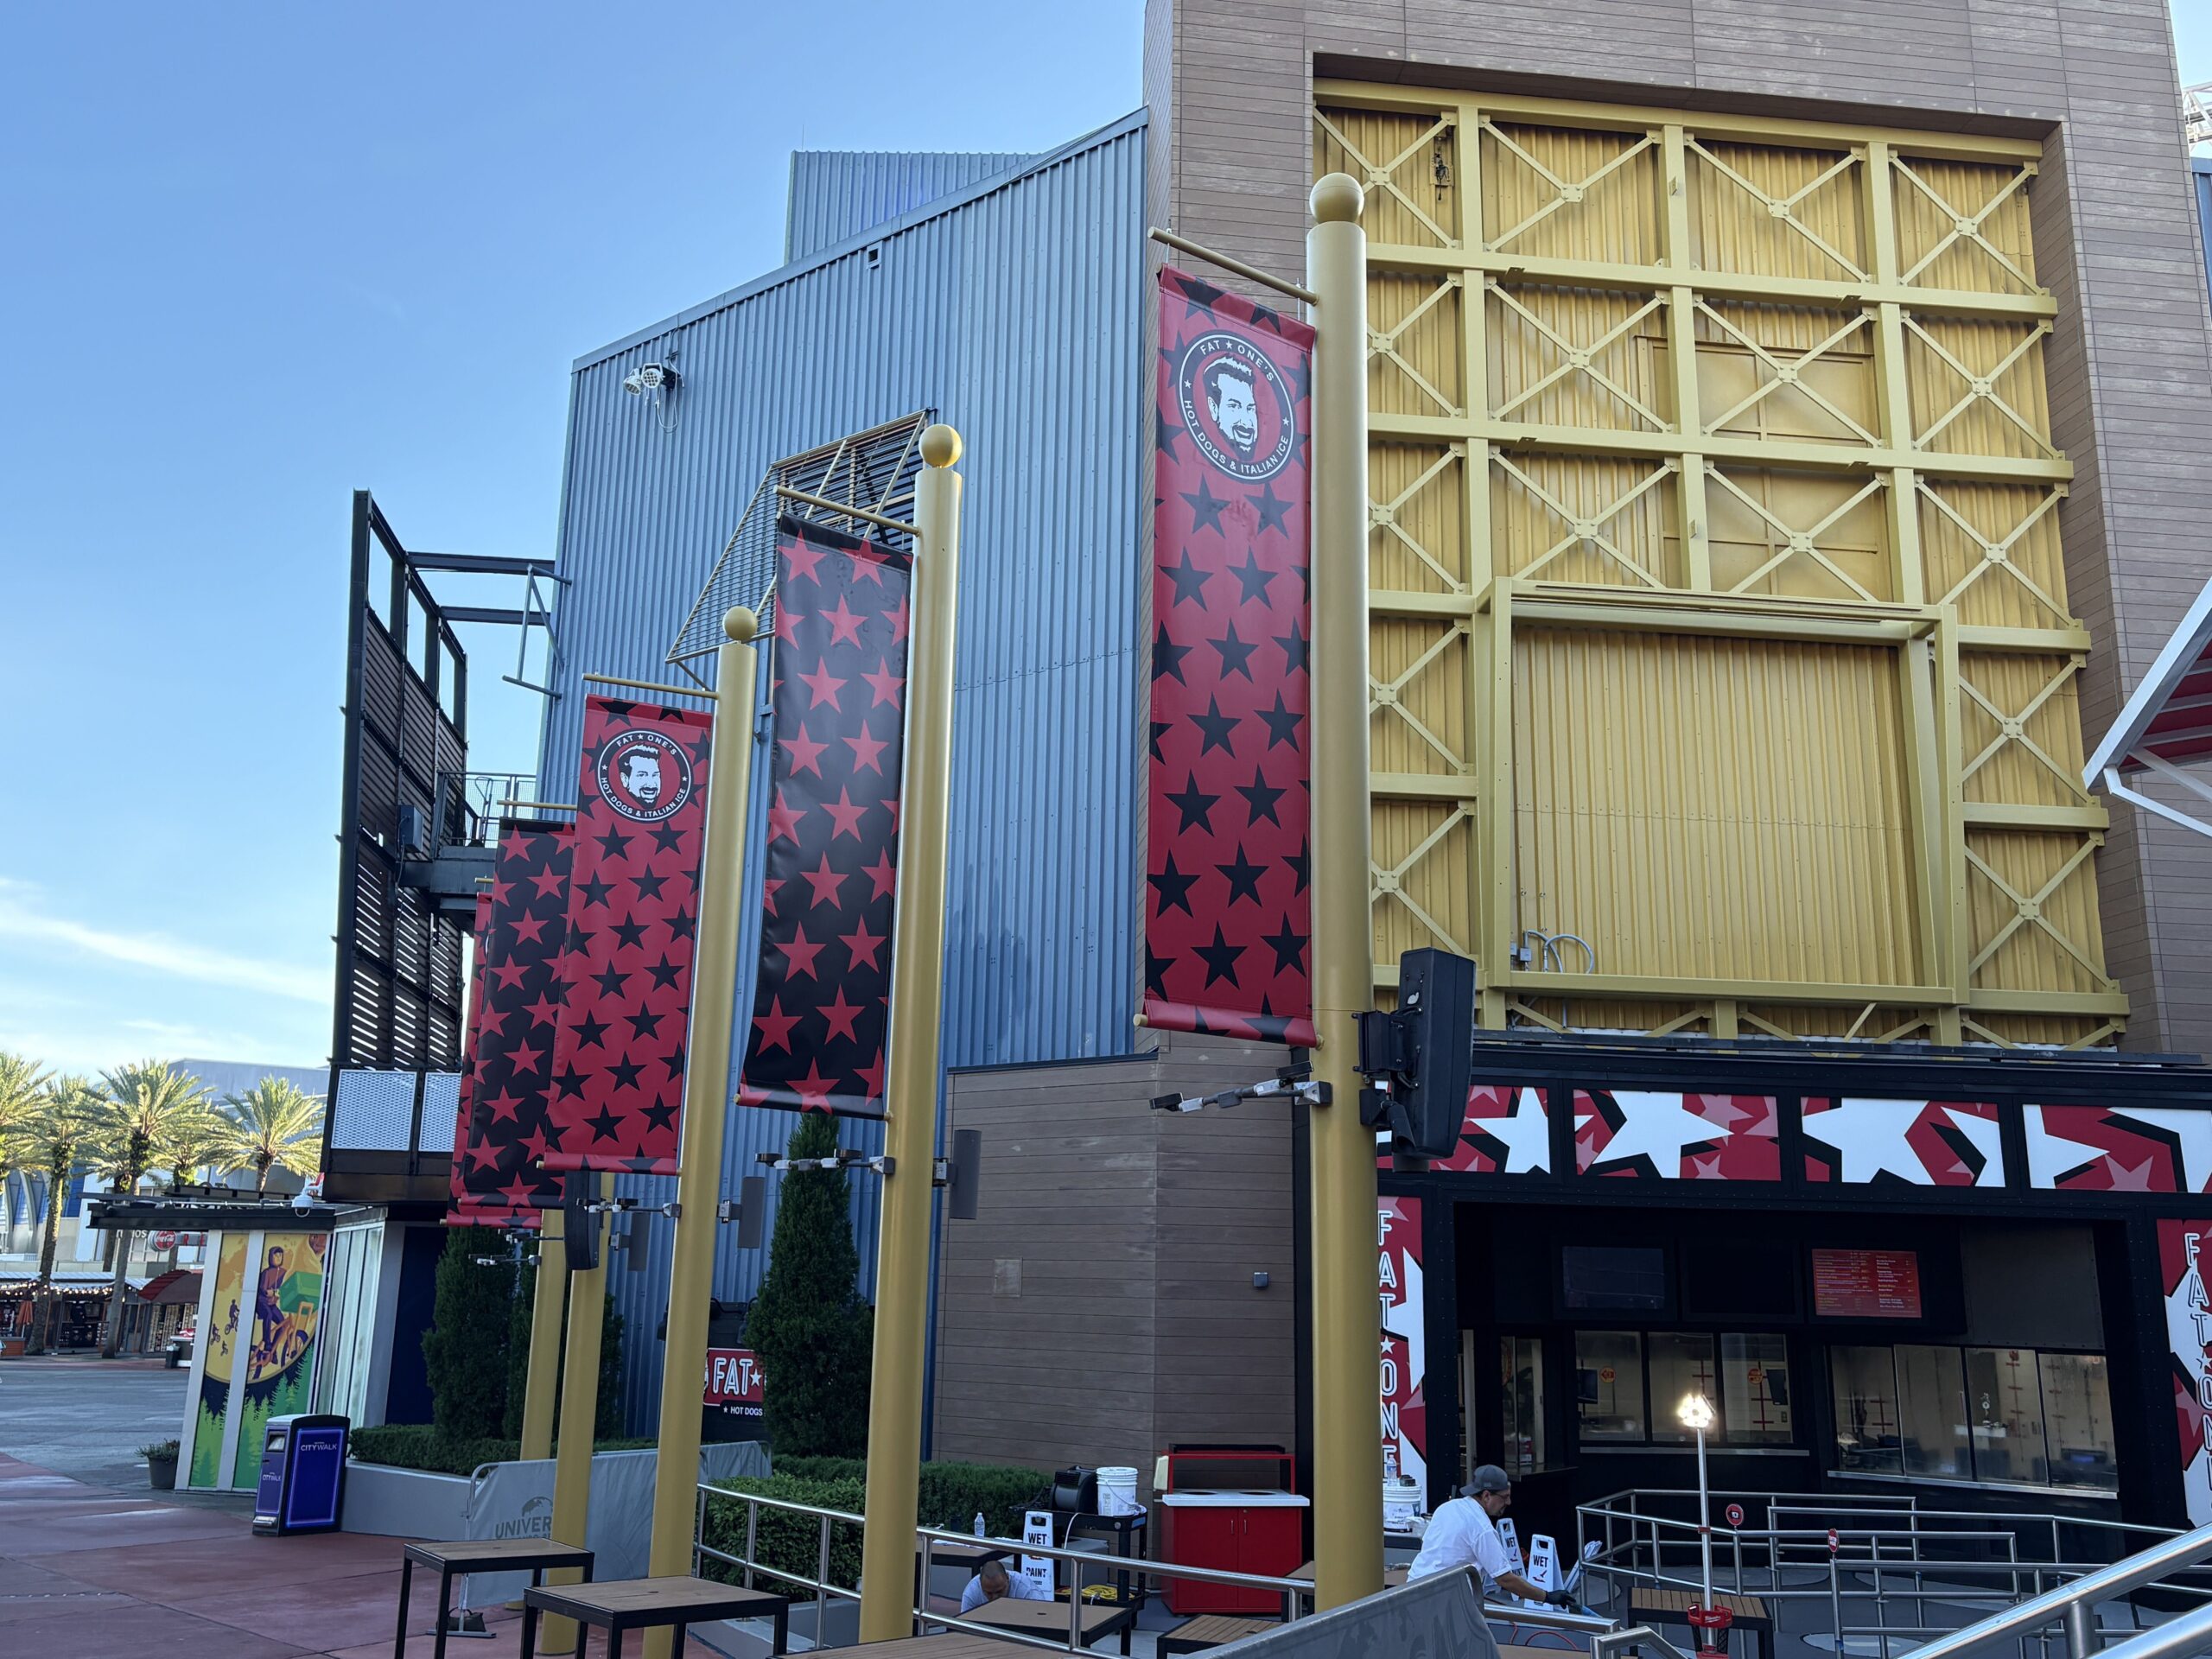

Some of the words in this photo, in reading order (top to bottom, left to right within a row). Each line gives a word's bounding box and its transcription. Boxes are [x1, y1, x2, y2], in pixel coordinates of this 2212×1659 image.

[1199, 340, 1220, 355] FAT
[1237, 345, 1274, 381] ONE'S
[1184, 400, 1200, 428] HOT
[1197, 433, 1226, 464] DOGS
[1230, 461, 1236, 470] &
[1241, 456, 1279, 474] ITALIAN
[1279, 435, 1289, 456] ICE
[617, 734, 633, 747] FAT
[647, 734, 677, 755] ONE'S
[601, 777, 613, 794] HOT
[610, 794, 632, 814] DOGS
[645, 803, 676, 817] ITALIAN
[675, 788, 686, 803] ICE
[1378, 1210, 1397, 1330] FAT
[2184, 1233, 2209, 1347] FAT
[713, 1357, 753, 1395] FAT
[730, 1406, 744, 1415] HOT
[745, 1407, 763, 1417] DOGS
[1028, 1533, 1047, 1545] WET
[1505, 1537, 1516, 1548] WET
[1026, 1567, 1047, 1578] PAINT
[1534, 1554, 1548, 1567] WET
